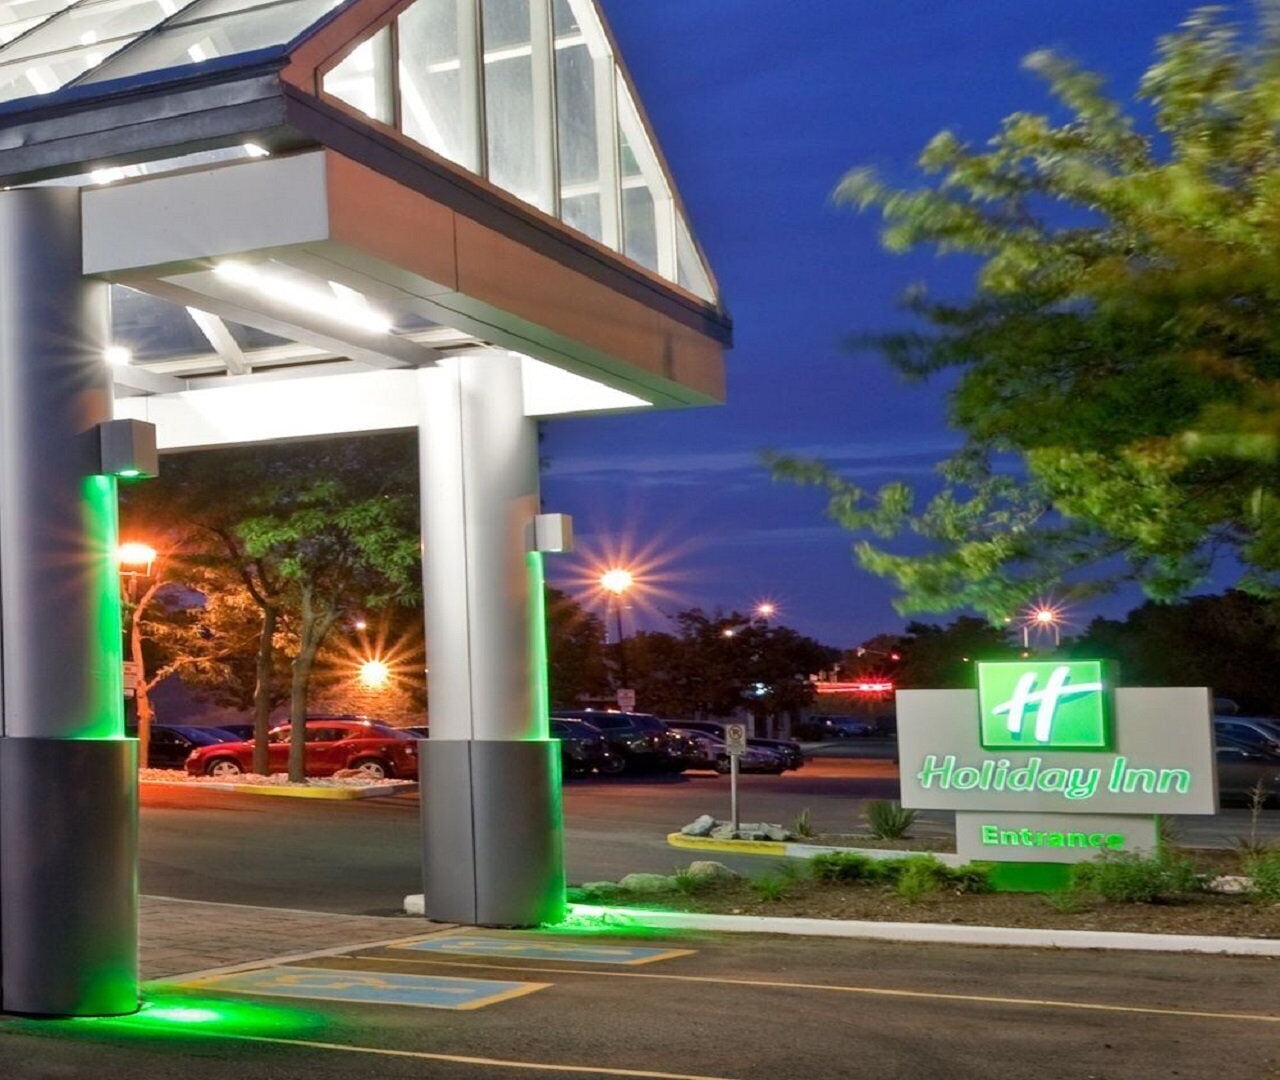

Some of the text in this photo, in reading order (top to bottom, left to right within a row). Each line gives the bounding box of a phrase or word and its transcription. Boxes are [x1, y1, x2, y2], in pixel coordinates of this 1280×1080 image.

[916, 755, 1191, 800] Holiday Inn
[981, 825, 1126, 850] Entrance
